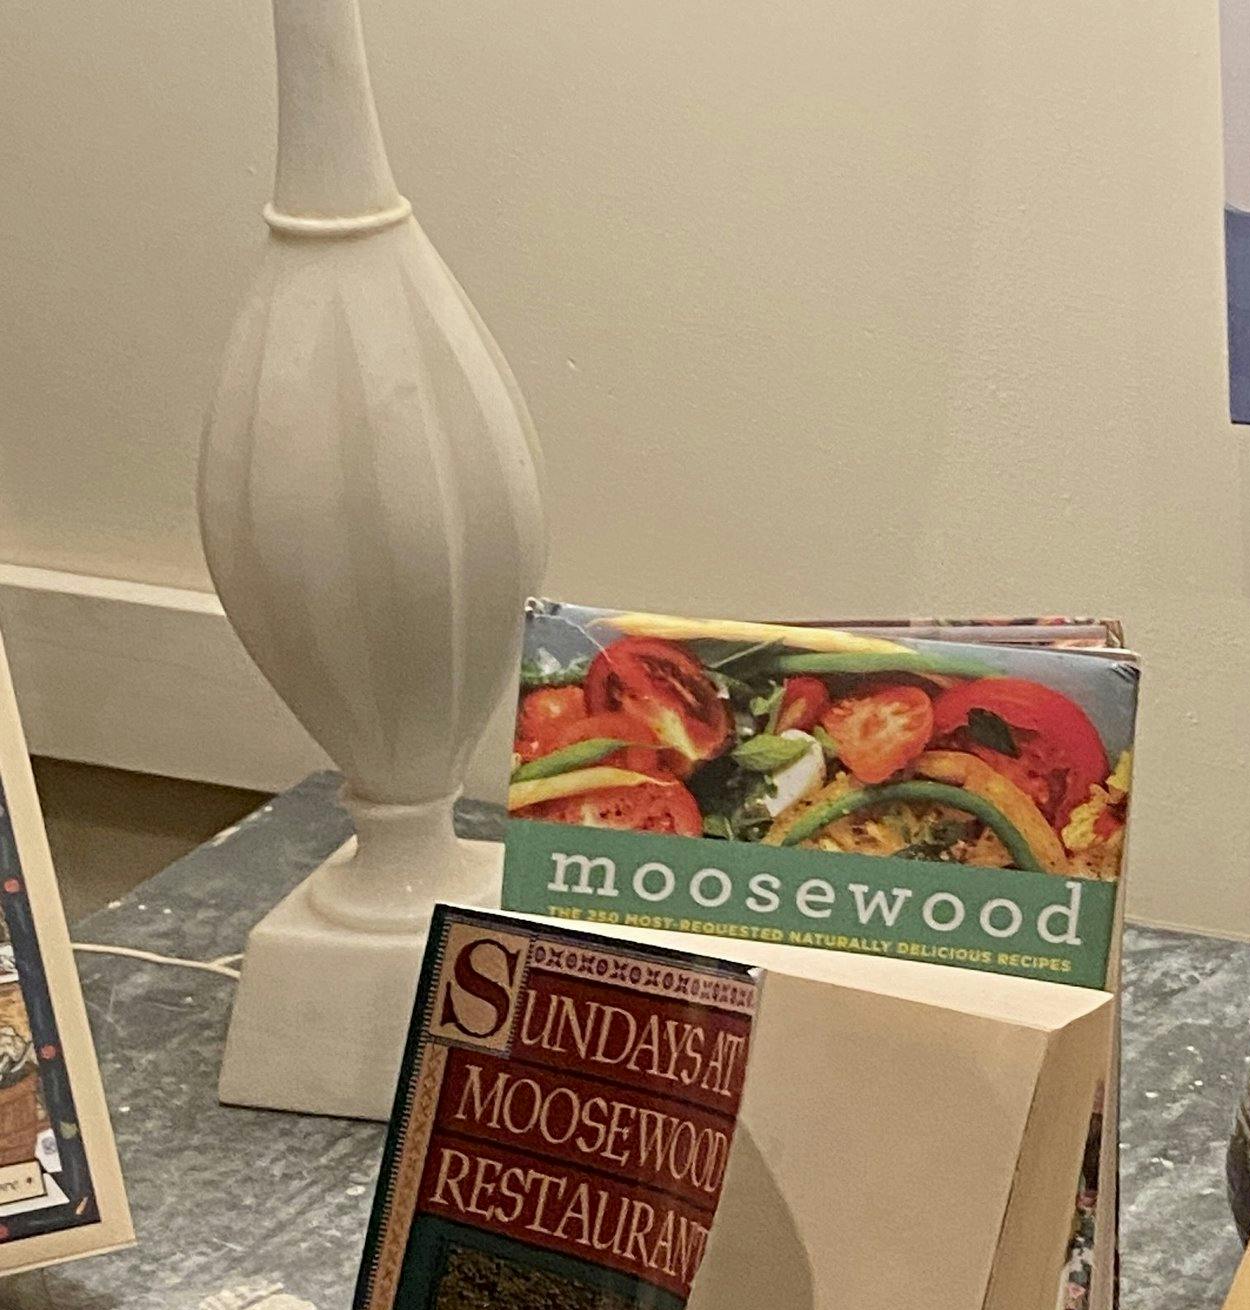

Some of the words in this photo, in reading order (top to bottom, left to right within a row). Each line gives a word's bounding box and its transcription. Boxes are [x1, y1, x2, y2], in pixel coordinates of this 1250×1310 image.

[547, 851, 1083, 947] moosewood
[547, 905, 579, 920] THE
[587, 909, 619, 924] 250
[624, 912, 784, 942] MOST-REQUESTED
[788, 930, 893, 953] NATURALLY
[896, 941, 994, 965] DELICIOUS
[997, 952, 1072, 973] RECIPES
[701, 1031, 745, 1097] AT
[454, 1064, 728, 1193] MOOSEWOOD
